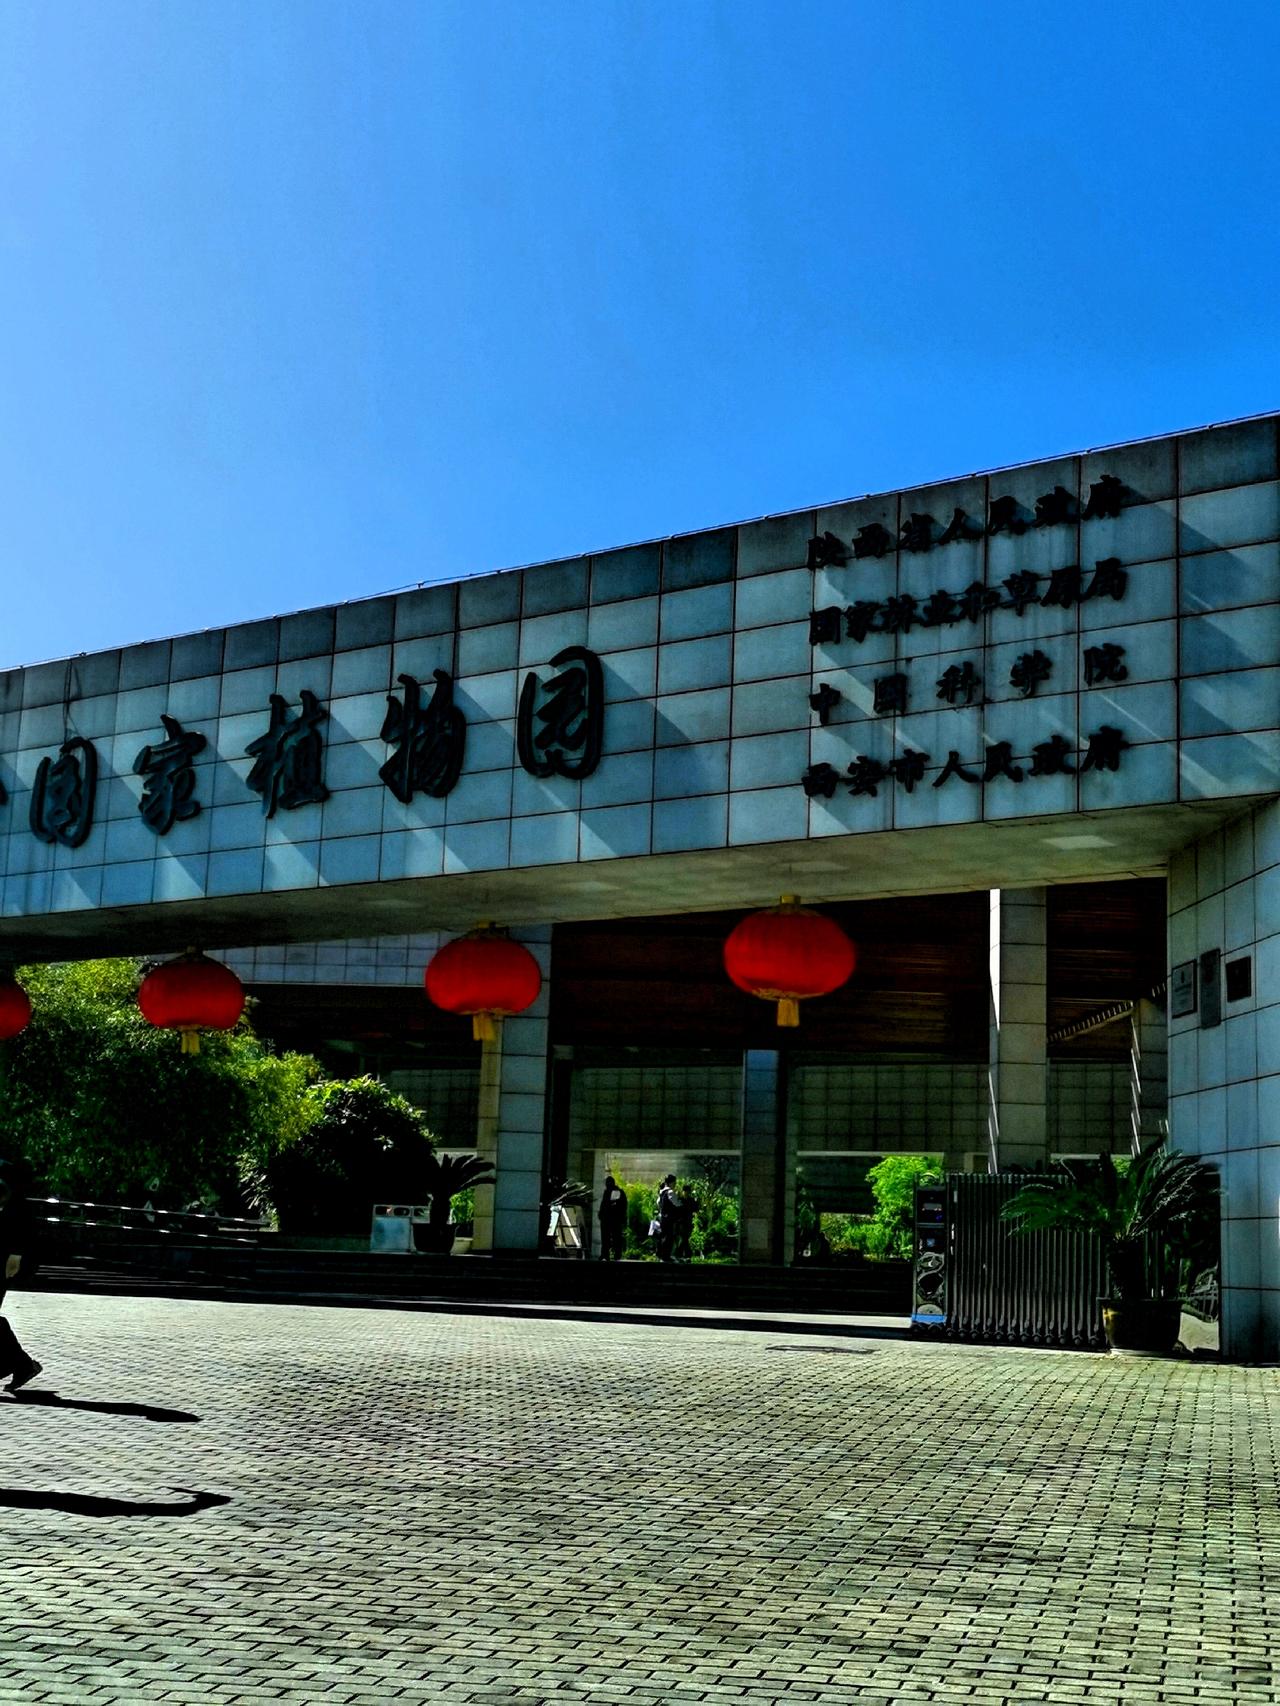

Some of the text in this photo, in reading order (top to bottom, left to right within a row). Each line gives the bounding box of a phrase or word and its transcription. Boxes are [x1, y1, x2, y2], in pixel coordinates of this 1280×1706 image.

[0, 645, 604, 848] 国家植物园
[809, 642, 1128, 725] 中国科学院
